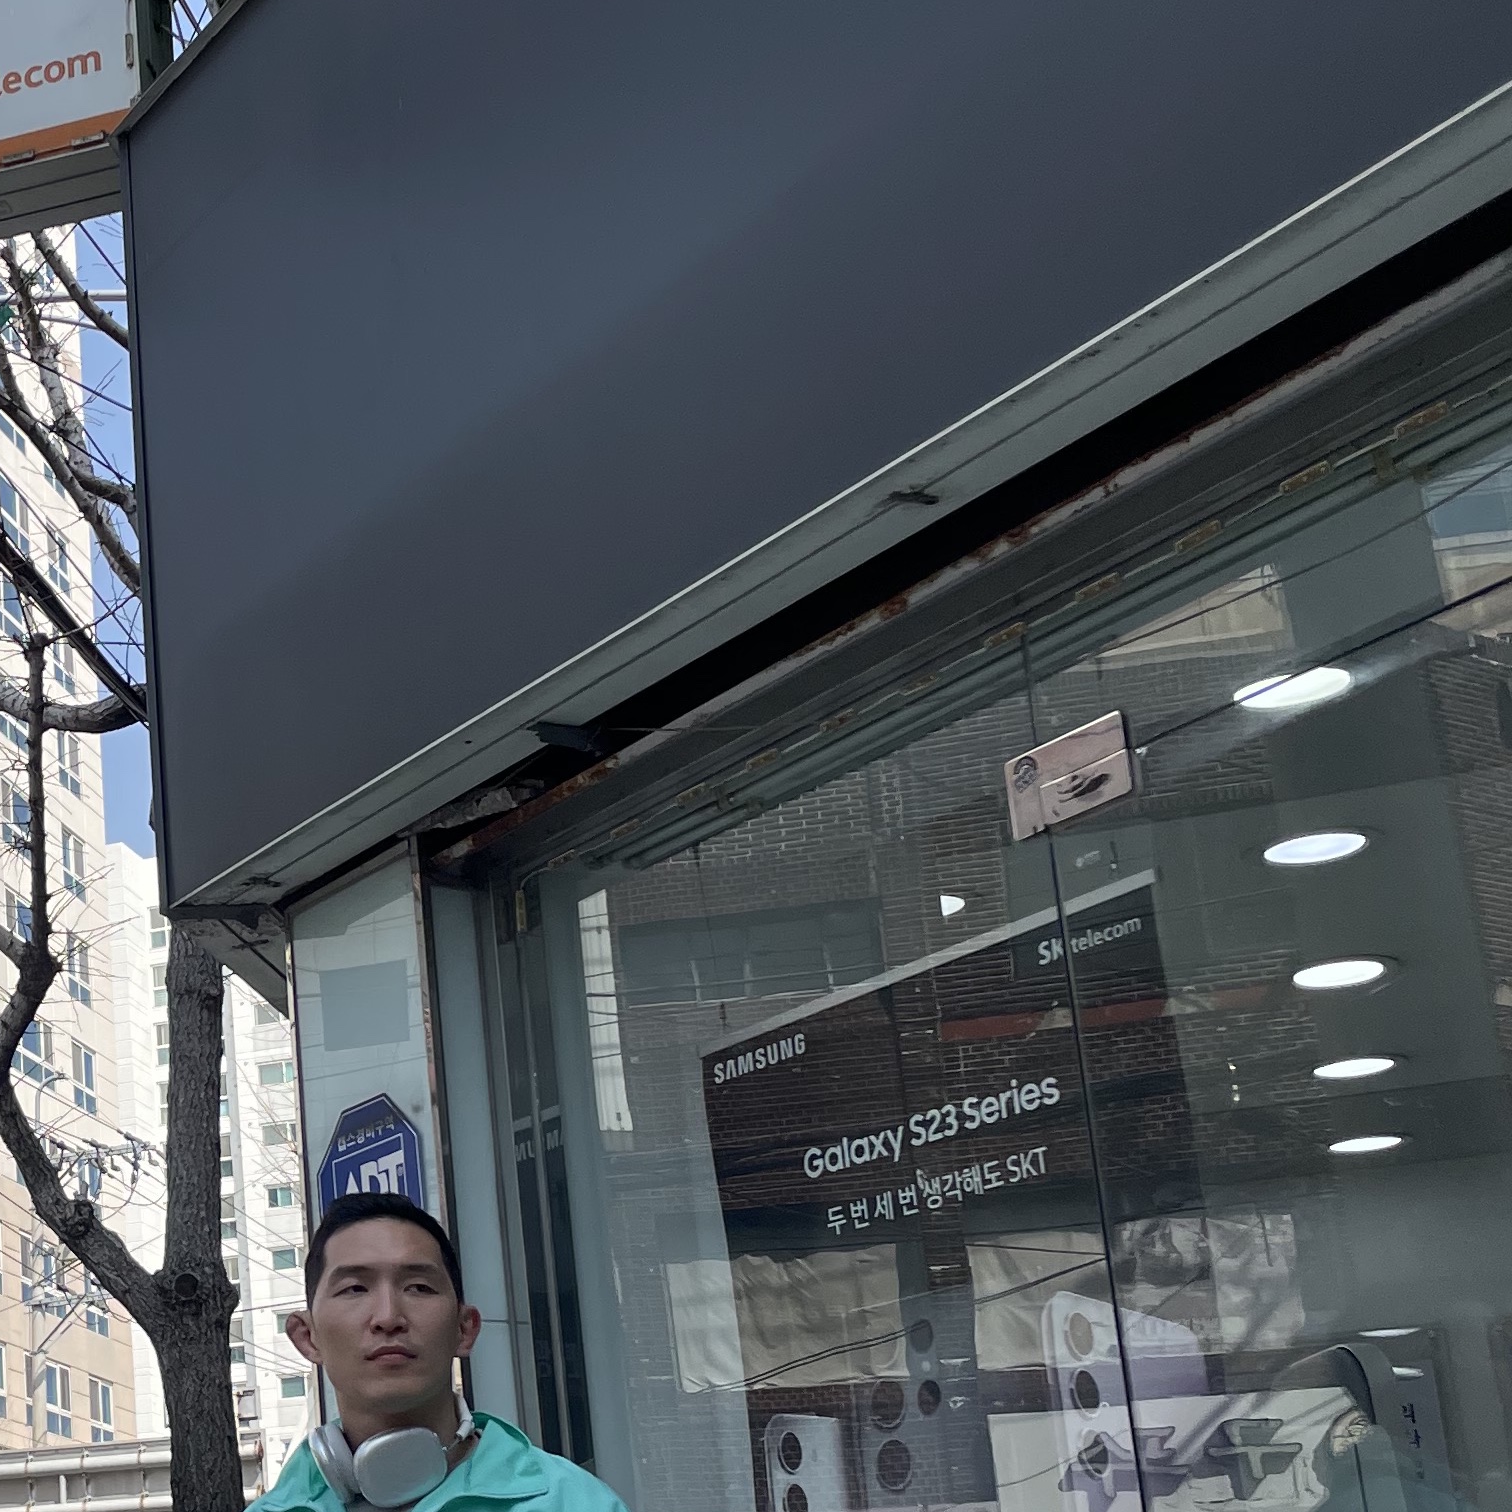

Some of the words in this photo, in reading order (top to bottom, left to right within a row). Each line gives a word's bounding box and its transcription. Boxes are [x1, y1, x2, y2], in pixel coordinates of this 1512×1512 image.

[1037, 937, 1065, 966] SK
[1069, 917, 1143, 954] telecom
[712, 1033, 806, 1085] SAMSUNG
[803, 1125, 905, 1179] Galaxy
[908, 1104, 959, 1147] S23
[962, 1076, 1061, 1131] Series
[826, 1205, 847, 1236] 두
[849, 1198, 870, 1230] 번
[873, 1190, 896, 1221] 세
[897, 1184, 920, 1217] 번
[921, 1160, 1005, 1210] 생각해도
[1006, 1146, 1048, 1184] SKT
